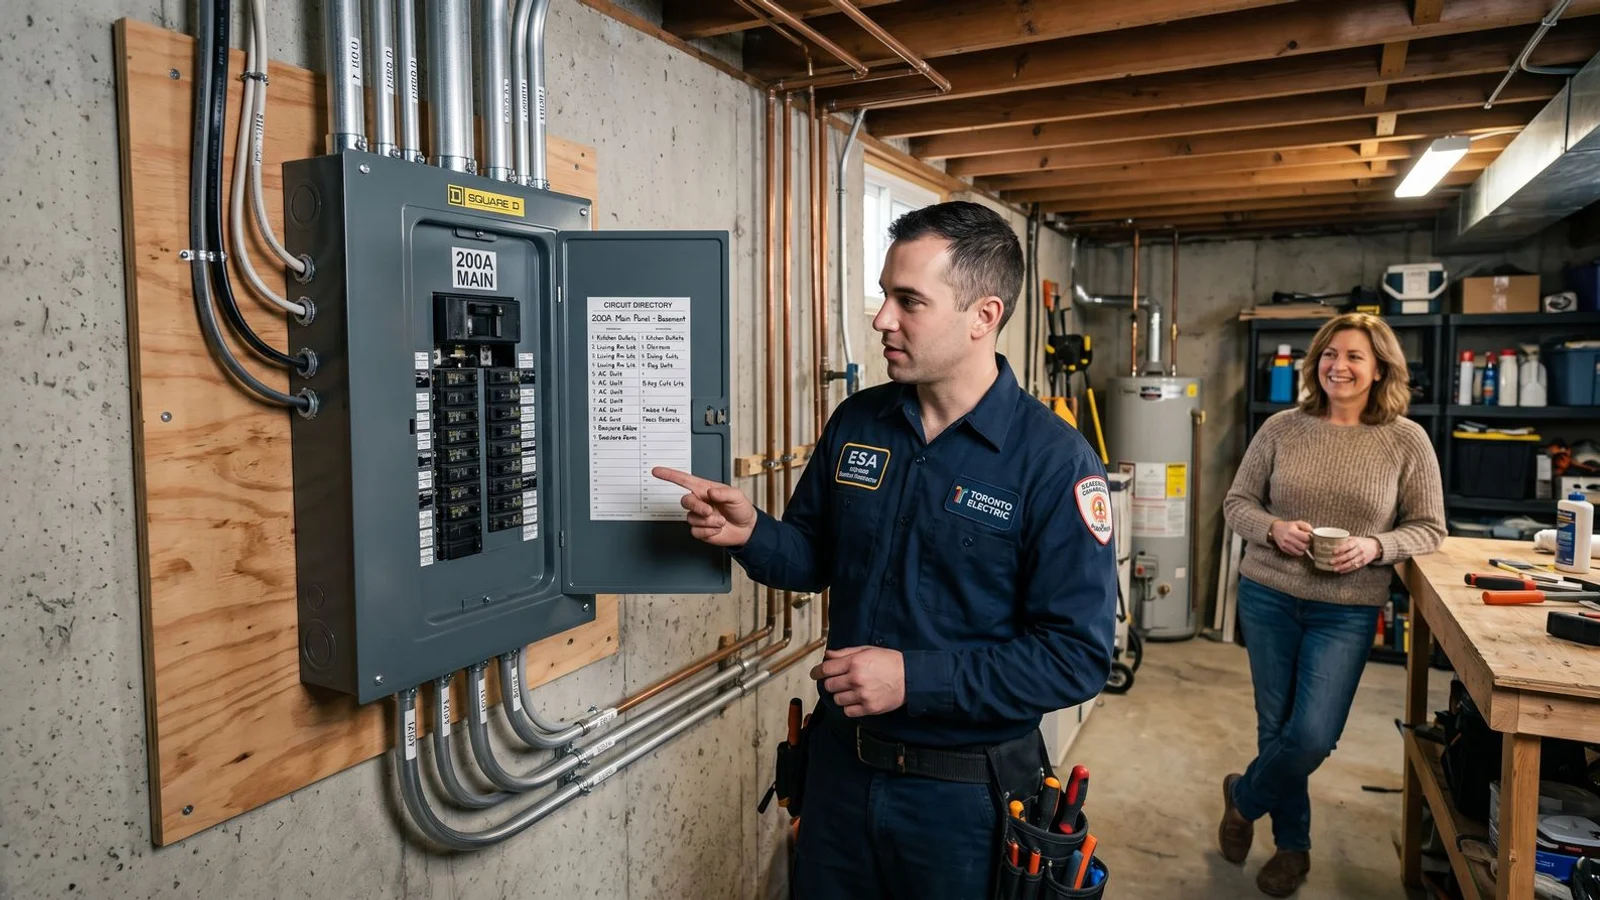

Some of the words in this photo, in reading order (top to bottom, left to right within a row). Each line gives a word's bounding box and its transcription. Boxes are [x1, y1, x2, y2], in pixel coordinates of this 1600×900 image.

[468, 193, 509, 209] SQUARE
[512, 201, 520, 210] D
[456, 250, 494, 271] 200A
[457, 269, 494, 288] MAIN
[603, 301, 631, 309] CIRCUIT
[633, 301, 673, 309] DIRECTORY
[591, 314, 612, 322] 200A
[615, 314, 631, 322] Main
[633, 313, 651, 322] Panel
[657, 314, 686, 322] Basement
[847, 450, 878, 469] ESA
[966, 499, 1010, 520] ELECTRIC
[970, 490, 1013, 511] TORONTO
